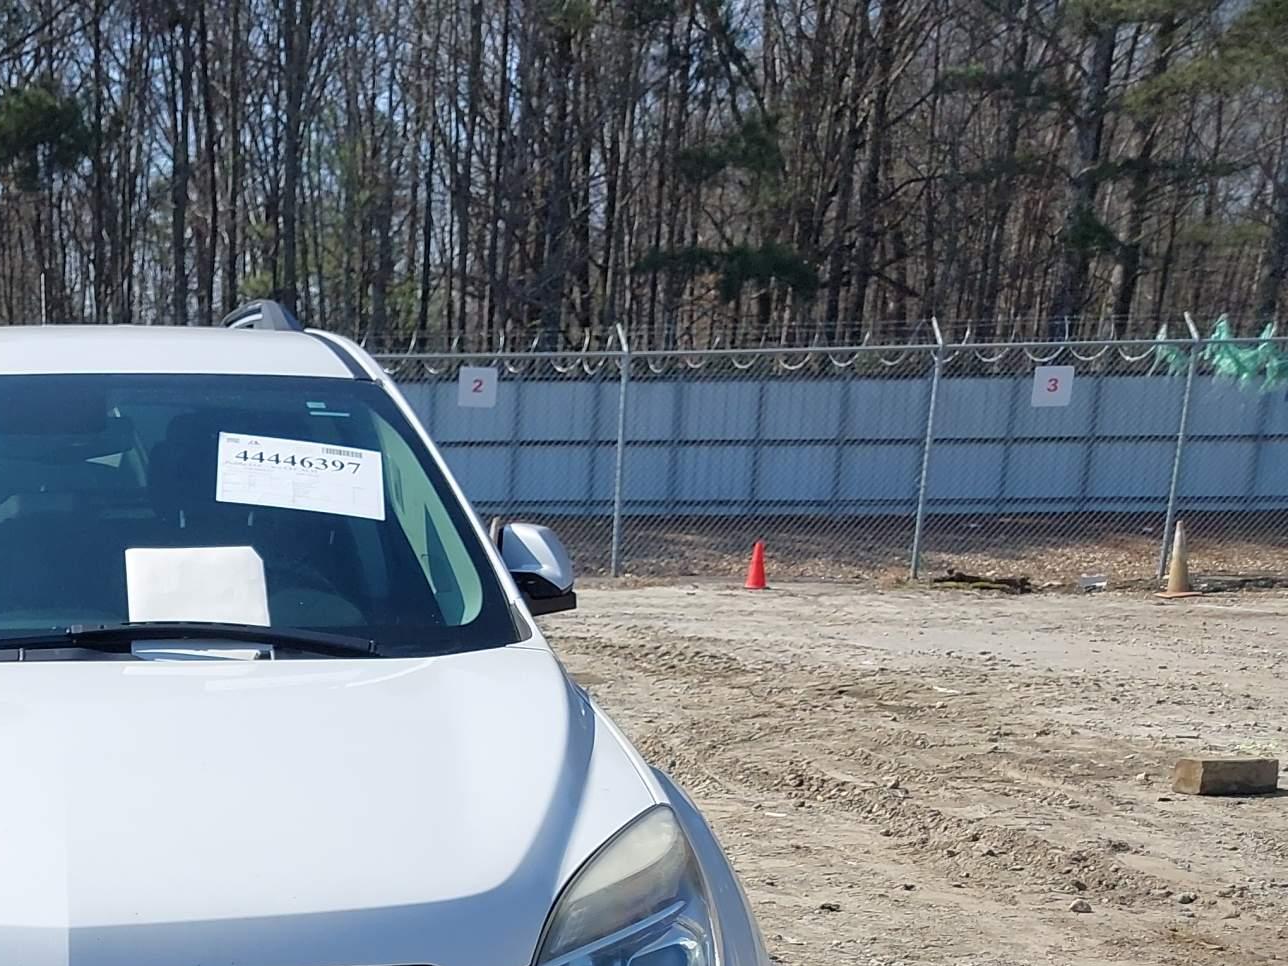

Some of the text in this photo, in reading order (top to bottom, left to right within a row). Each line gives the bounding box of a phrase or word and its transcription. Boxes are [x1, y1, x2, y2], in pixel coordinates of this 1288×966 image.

[471, 378, 483, 394] 2
[1046, 377, 1059, 393] 3
[234, 449, 361, 475] 44446397
